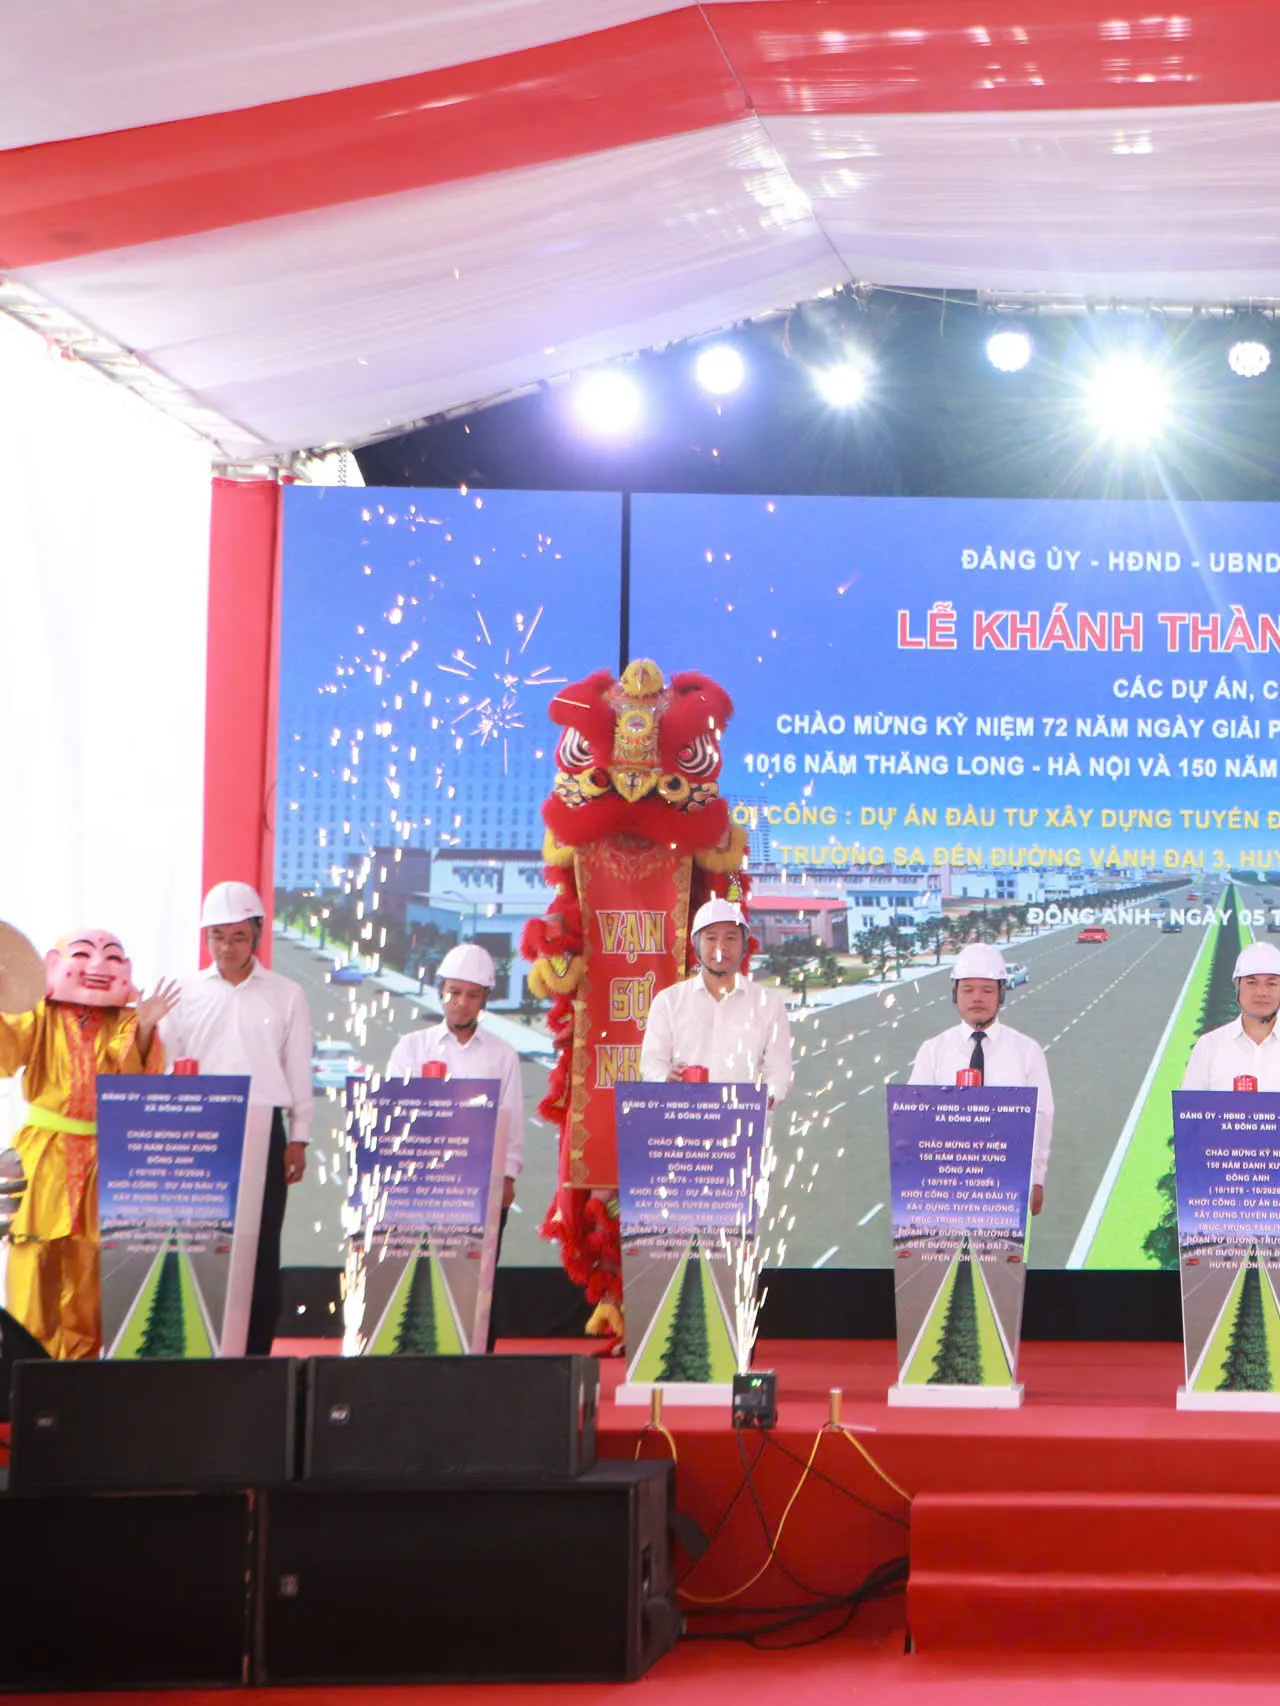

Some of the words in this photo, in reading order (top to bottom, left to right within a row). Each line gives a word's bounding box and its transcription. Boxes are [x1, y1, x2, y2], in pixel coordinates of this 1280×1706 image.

[961, 545, 1036, 571] ĐẢNG
[1046, 545, 1082, 571] ỦY
[1108, 549, 1182, 572] HĐND
[897, 601, 957, 650] LỄ
[973, 603, 1143, 652] KHÁNH
[1113, 674, 1163, 699] CÁC
[1171, 679, 1209, 704] DỰ
[1214, 676, 1255, 702] ÁN,
[776, 710, 846, 735] CHÀO
[854, 711, 928, 736] MỪNG
[936, 712, 969, 736] KỶ
[976, 714, 1034, 741] NIỆM
[1042, 717, 1068, 737] 72
[1076, 714, 1129, 738] NĂM
[1137, 714, 1205, 738] NGÀY
[1211, 715, 1260, 739] GIẢI
[744, 756, 796, 776] 1016
[804, 752, 857, 776] NĂM
[864, 752, 949, 776] THĂNG
[957, 755, 1025, 776] LONG
[1048, 752, 1081, 776] HÀ
[1089, 754, 1130, 781] NỘI
[1137, 753, 1171, 777] VÀ
[1178, 757, 1217, 777] 150
[1225, 754, 1278, 778] NĂM
[766, 801, 837, 826] CÔNG
[860, 807, 897, 830] DỰ
[903, 804, 937, 826] ÁN
[945, 804, 996, 827] ĐẦU
[1004, 807, 1039, 828] TƯ
[1046, 804, 1093, 828] XÂY
[1101, 808, 1172, 832] DỰNG
[1180, 806, 1259, 830] TUYẾN
[779, 843, 886, 867] TRƯỜNG
[893, 847, 926, 867] SA
[932, 843, 983, 868] ĐẾN
[989, 844, 1082, 868] ĐƯỜNG
[1089, 845, 1156, 869] VÀNH
[1163, 849, 1205, 869] ĐAI
[1213, 850, 1231, 873] 3,
[1027, 904, 1096, 925] ĐÔNG
[1101, 909, 1151, 925] ANH
[1170, 904, 1233, 926] NGÀY
[1238, 909, 1265, 926] 05
[596, 910, 667, 963] VẠN
[611, 971, 655, 1029] SỰ
